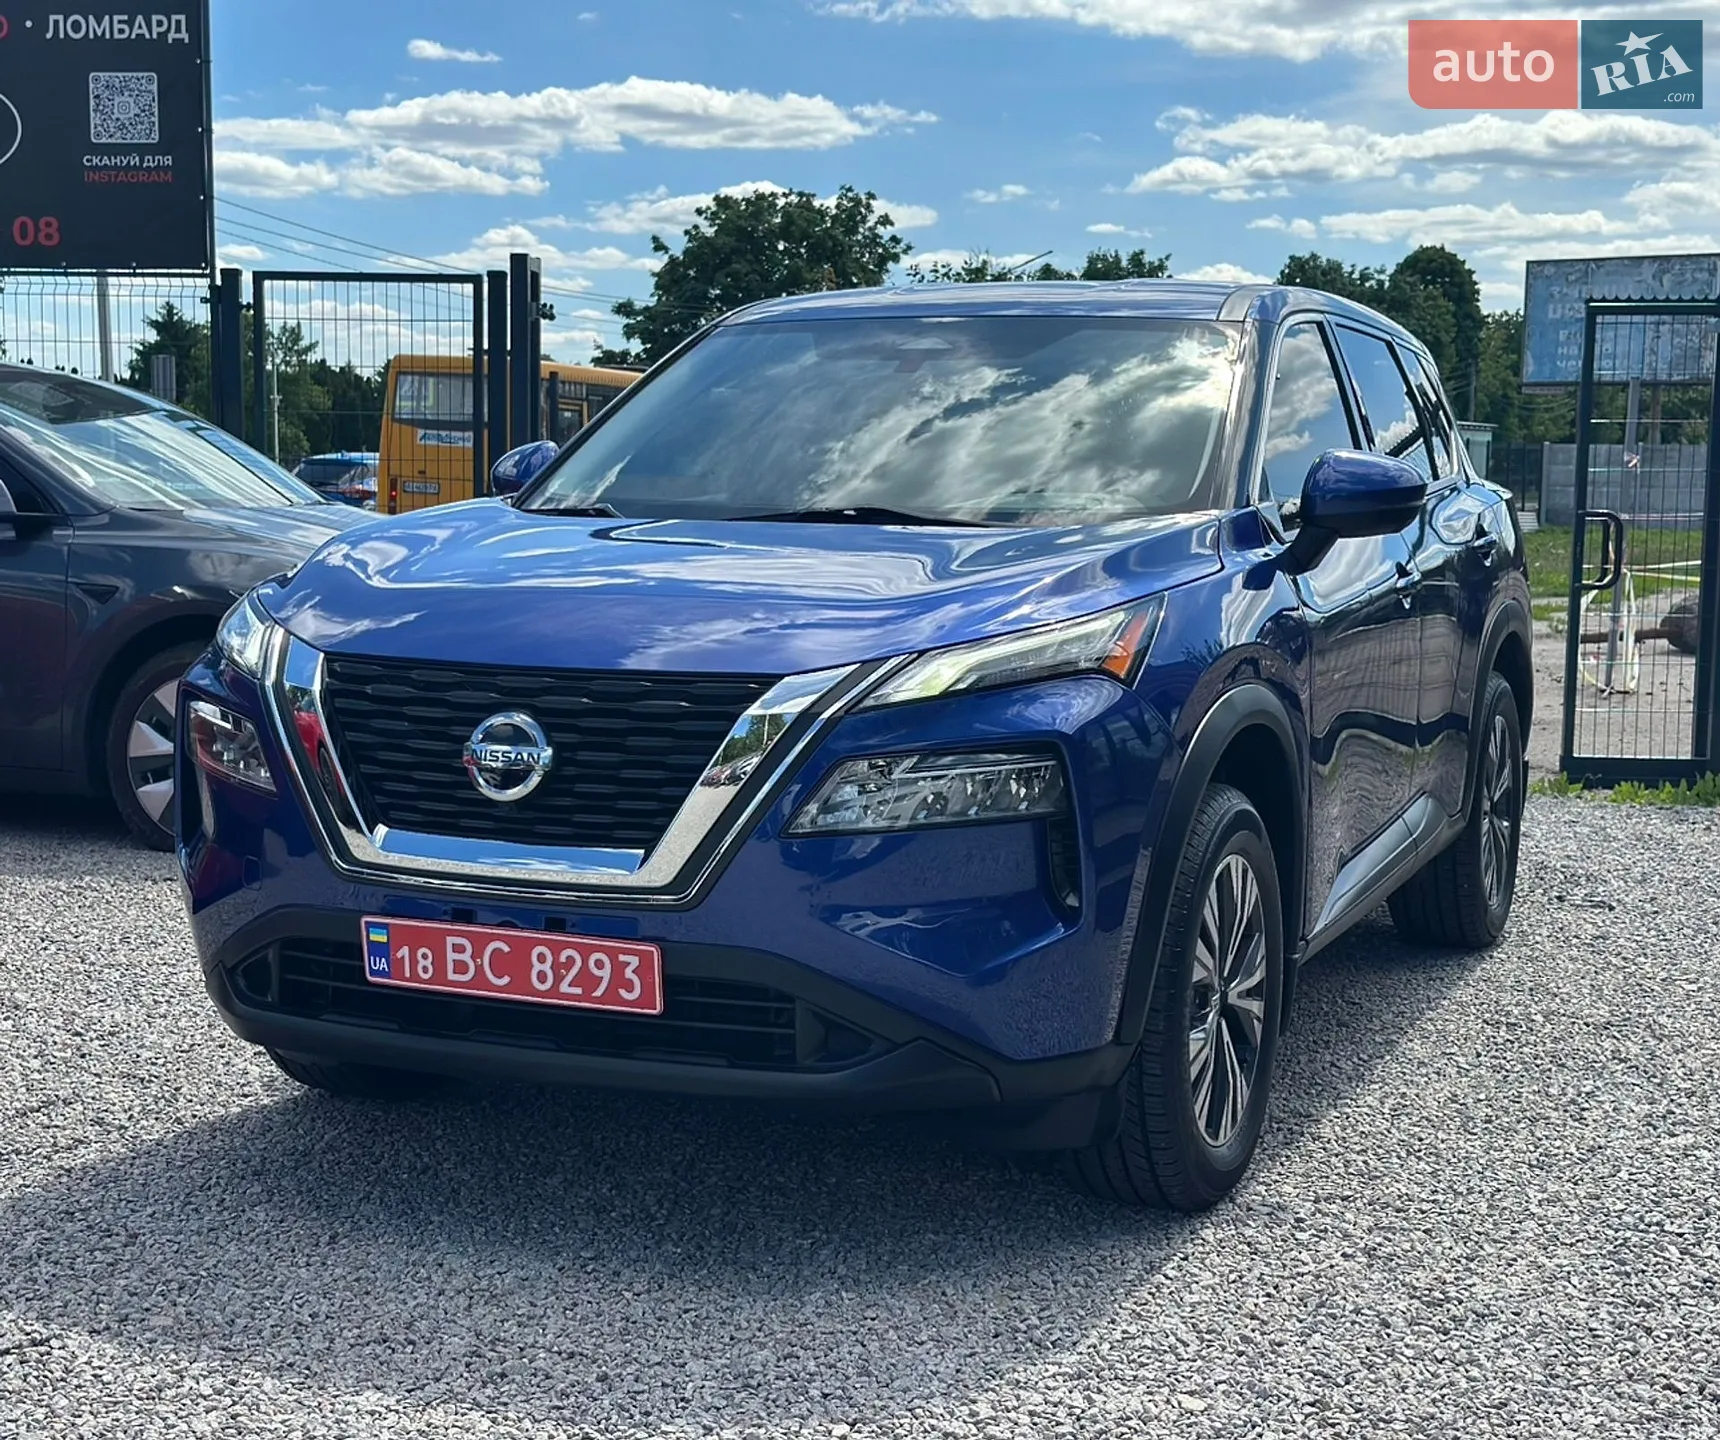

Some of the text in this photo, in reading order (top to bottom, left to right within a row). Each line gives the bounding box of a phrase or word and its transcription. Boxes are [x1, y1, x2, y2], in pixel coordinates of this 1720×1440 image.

[46, 14, 189, 43] ЛОМБАРД
[83, 153, 172, 167] СКАНУЙ ДЛЯ
[84, 170, 172, 182] INSTAGRAM
[12, 216, 60, 246] 08
[472, 748, 540, 765] NISSAN
[370, 955, 388, 972] UA
[395, 936, 642, 1000] 18 BC 8293
